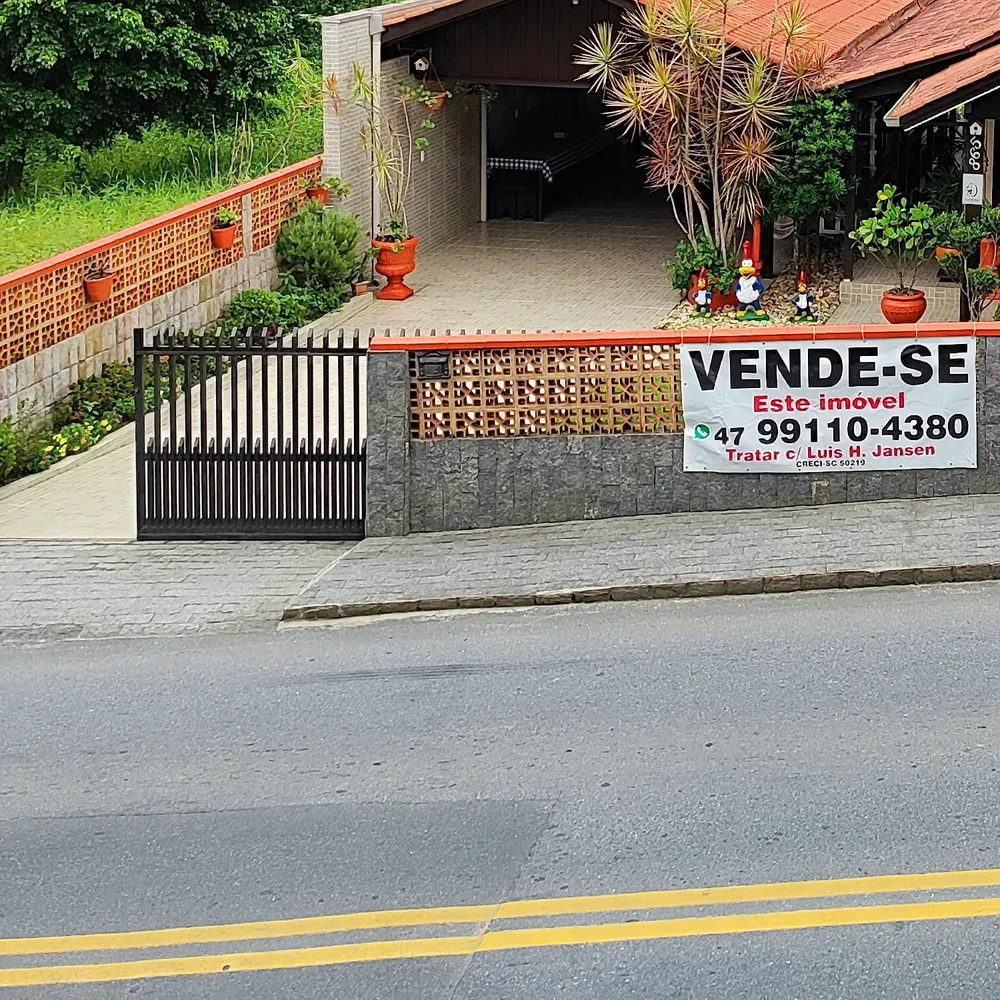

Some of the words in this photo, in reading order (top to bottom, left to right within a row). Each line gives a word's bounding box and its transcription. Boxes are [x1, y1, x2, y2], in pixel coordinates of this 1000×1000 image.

[688, 343, 970, 391] VENDE-SE
[753, 395, 811, 413] Este
[818, 392, 905, 411] imóvel
[714, 427, 745, 446] 47
[757, 413, 970, 445] 99110-4380
[725, 448, 780, 462] Tratar
[785, 446, 802, 461] c/
[807, 446, 843, 459] Luis
[849, 446, 866, 458] H.
[872, 444, 936, 457] Jansen
[839, 458, 866, 467] 50219
